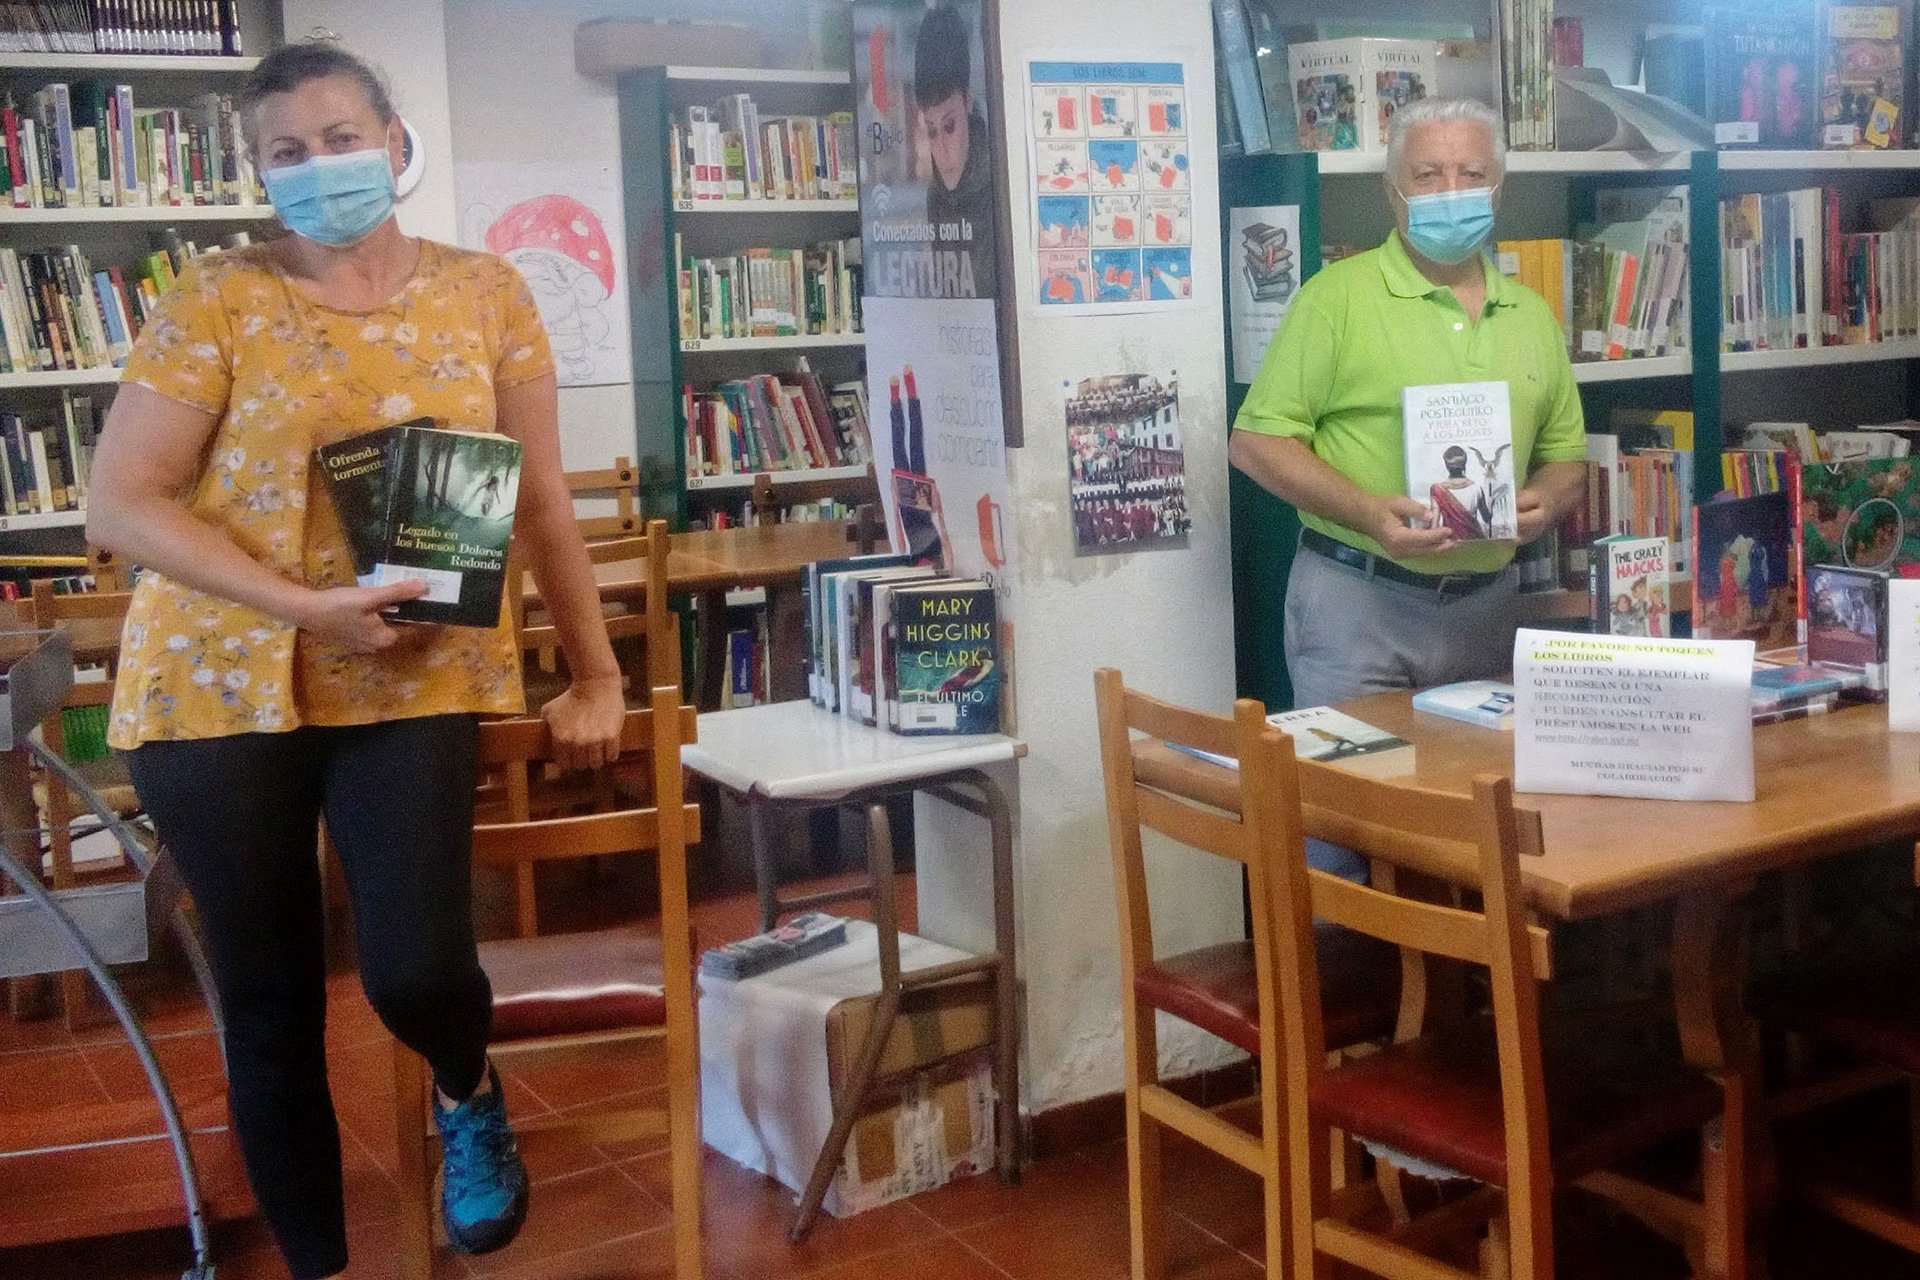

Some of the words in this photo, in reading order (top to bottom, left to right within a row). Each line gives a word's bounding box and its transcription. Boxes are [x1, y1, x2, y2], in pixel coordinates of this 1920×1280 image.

[1301, 55, 1353, 68] VIRTUAL
[1378, 52, 1421, 64] VIRTUAL
[1073, 67, 1089, 78] LOS
[1128, 68, 1146, 79] SON
[678, 200, 694, 210] 635
[873, 220, 936, 242] Conectados
[939, 223, 960, 242] con
[962, 218, 973, 241] la
[874, 250, 977, 298] LECTURA
[684, 339, 701, 350] 629
[329, 446, 381, 469] Ofrenda
[399, 523, 442, 539] Legado
[444, 531, 459, 541] en
[395, 536, 413, 547] los
[415, 538, 457, 552] huesos
[458, 544, 503, 557] Dolores
[1614, 551, 1632, 564] THE
[1634, 546, 1664, 561] CRAZY
[450, 555, 502, 571] Redondo
[1616, 559, 1664, 579] HAACKS
[922, 598, 974, 616] MARY
[907, 623, 992, 642] HIGGINS
[1534, 651, 1559, 660] LOS
[1563, 652, 1613, 662] LIBROS
[1634, 644, 1653, 652] NO
[1658, 646, 1715, 656] TOQUEN
[918, 650, 981, 669] CLARK
[1542, 665, 1614, 676] SOLICITEN
[1618, 668, 1635, 677] EL
[1638, 668, 1710, 680] EJEMPLAR
[1533, 678, 1562, 688] QUE
[1564, 679, 1617, 690] DESEAN
[1620, 682, 1630, 690] O
[1634, 682, 1663, 692] UNA
[918, 691, 930, 703] EL
[1543, 706, 1598, 716] PUEDEN
[1601, 708, 1685, 720] CONSULTAR
[1688, 712, 1707, 721] EL
[1619, 722, 1637, 731] EN
[1640, 723, 1657, 731] LA
[1661, 724, 1692, 734] WEB
[1570, 760, 1616, 770] MUCHAS
[1617, 762, 1666, 772] GRACIAS
[1668, 764, 1690, 773] POR
